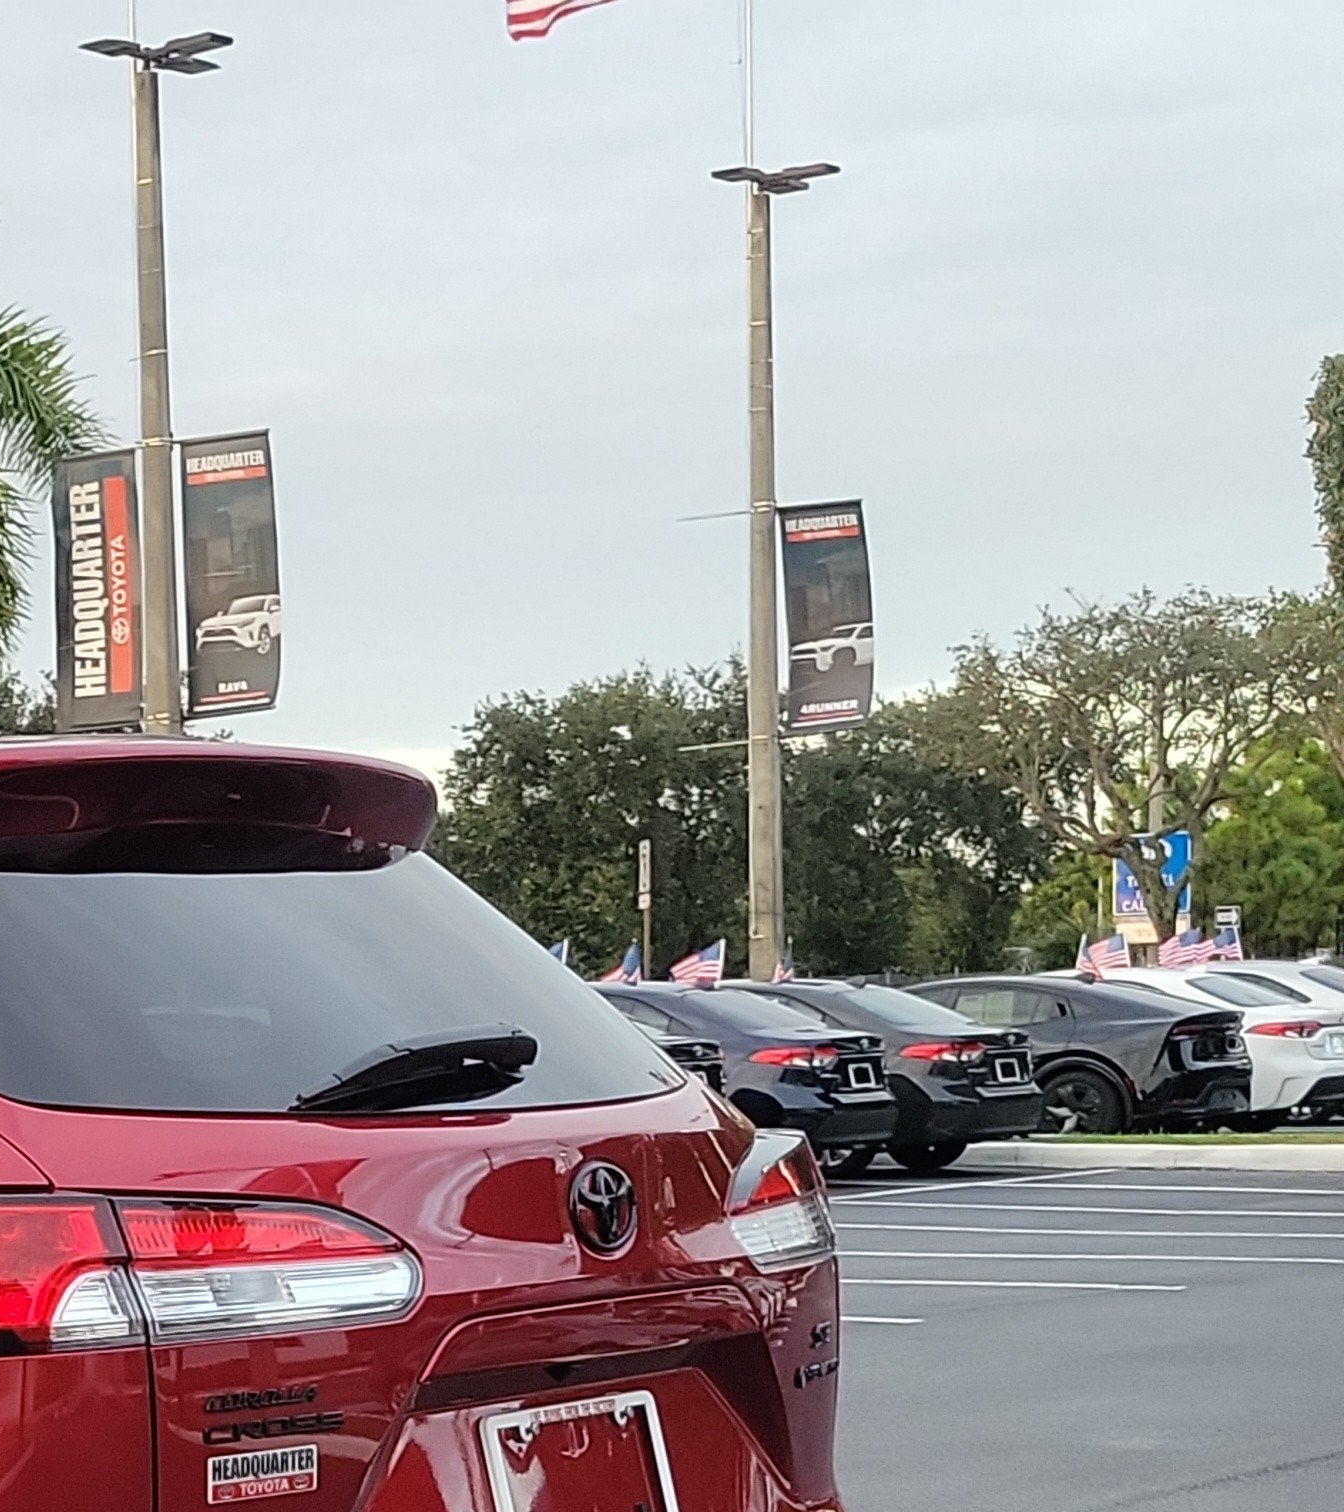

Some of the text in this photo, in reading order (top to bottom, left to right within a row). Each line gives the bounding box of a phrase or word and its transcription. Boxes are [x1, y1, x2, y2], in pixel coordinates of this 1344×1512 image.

[185, 449, 265, 474] HEADQUARTER
[70, 481, 109, 698] HEADQUARTER
[111, 534, 128, 617] TOYOTA
[203, 1411, 344, 1445] CROSS
[212, 1447, 315, 1482] HEADQUARTER
[239, 1478, 290, 1498] TOYOTA
